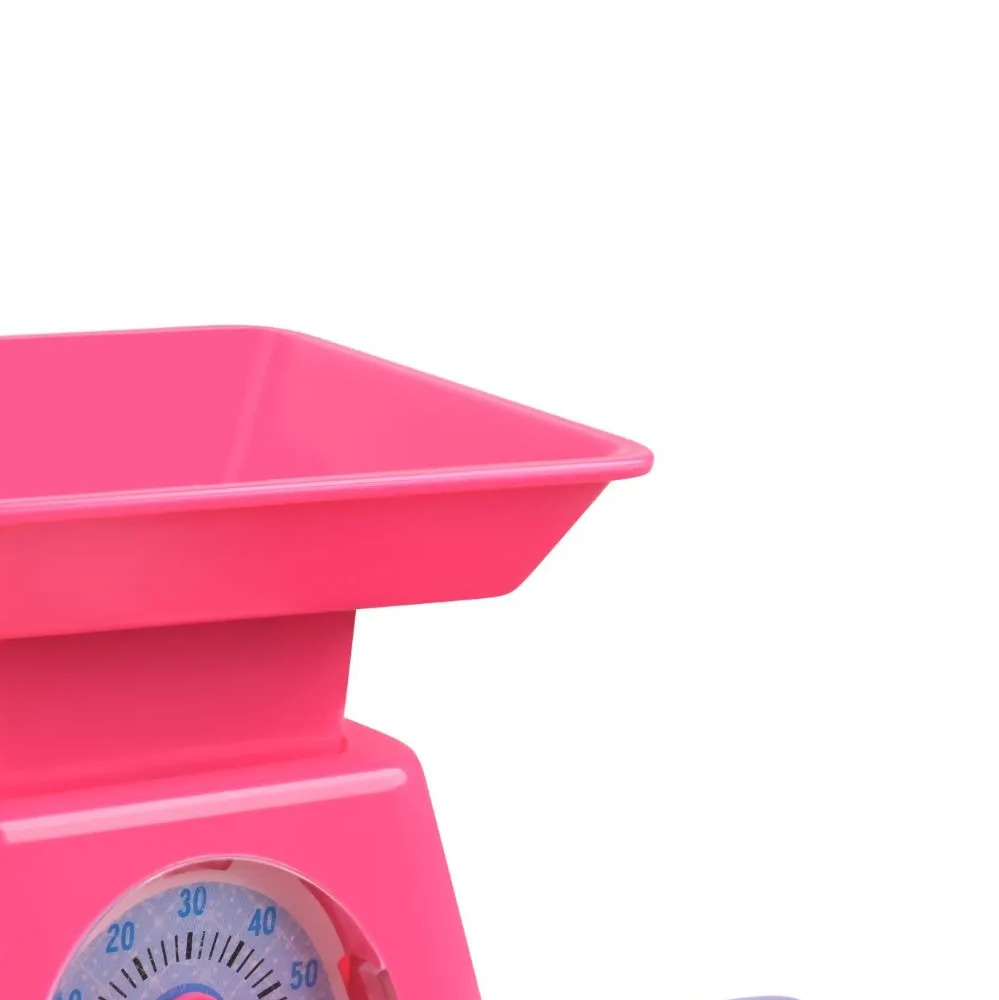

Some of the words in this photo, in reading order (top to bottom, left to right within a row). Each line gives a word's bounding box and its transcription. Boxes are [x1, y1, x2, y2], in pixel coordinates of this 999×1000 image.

[177, 886, 207, 917] 30
[248, 906, 277, 936] 40
[105, 921, 135, 953] 20
[290, 960, 318, 991] 50
